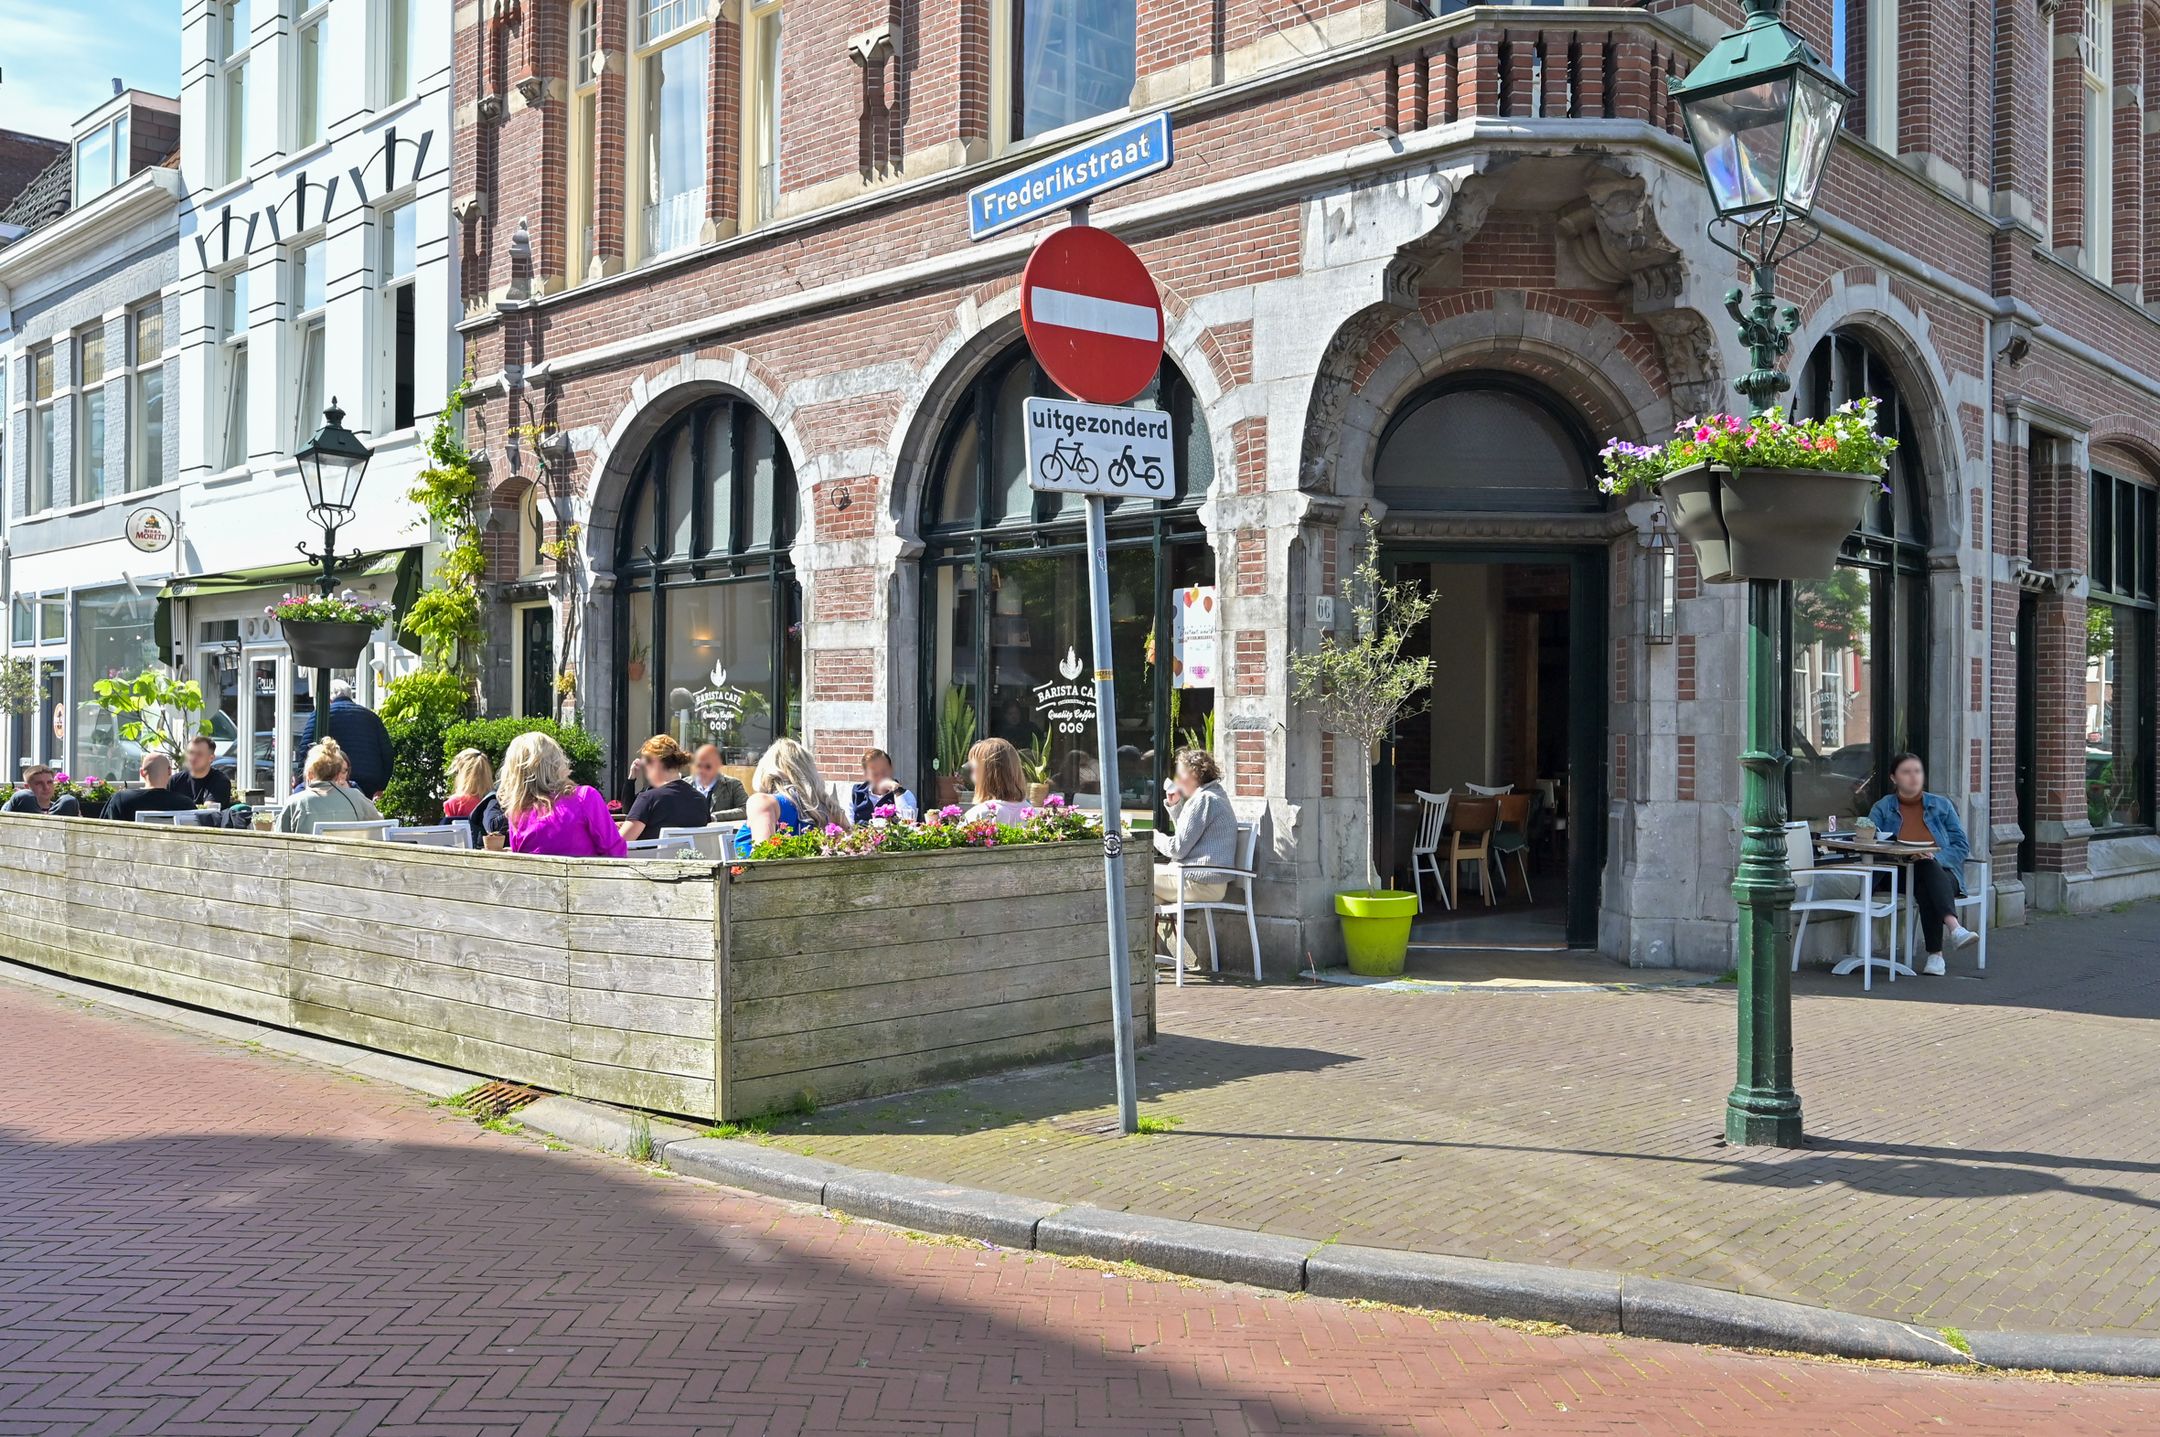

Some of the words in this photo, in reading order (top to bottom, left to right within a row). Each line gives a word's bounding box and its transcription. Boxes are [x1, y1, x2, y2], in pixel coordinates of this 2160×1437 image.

[982, 132, 1150, 220] Frederikstraat
[1032, 407, 1168, 440] uitgezonderd
[695, 691, 724, 706] BARISTA
[1037, 685, 1079, 703] BARISTA
[1080, 685, 1097, 700] CA
[1048, 709, 1073, 721] Quality
[1073, 708, 1096, 721] Coffee
